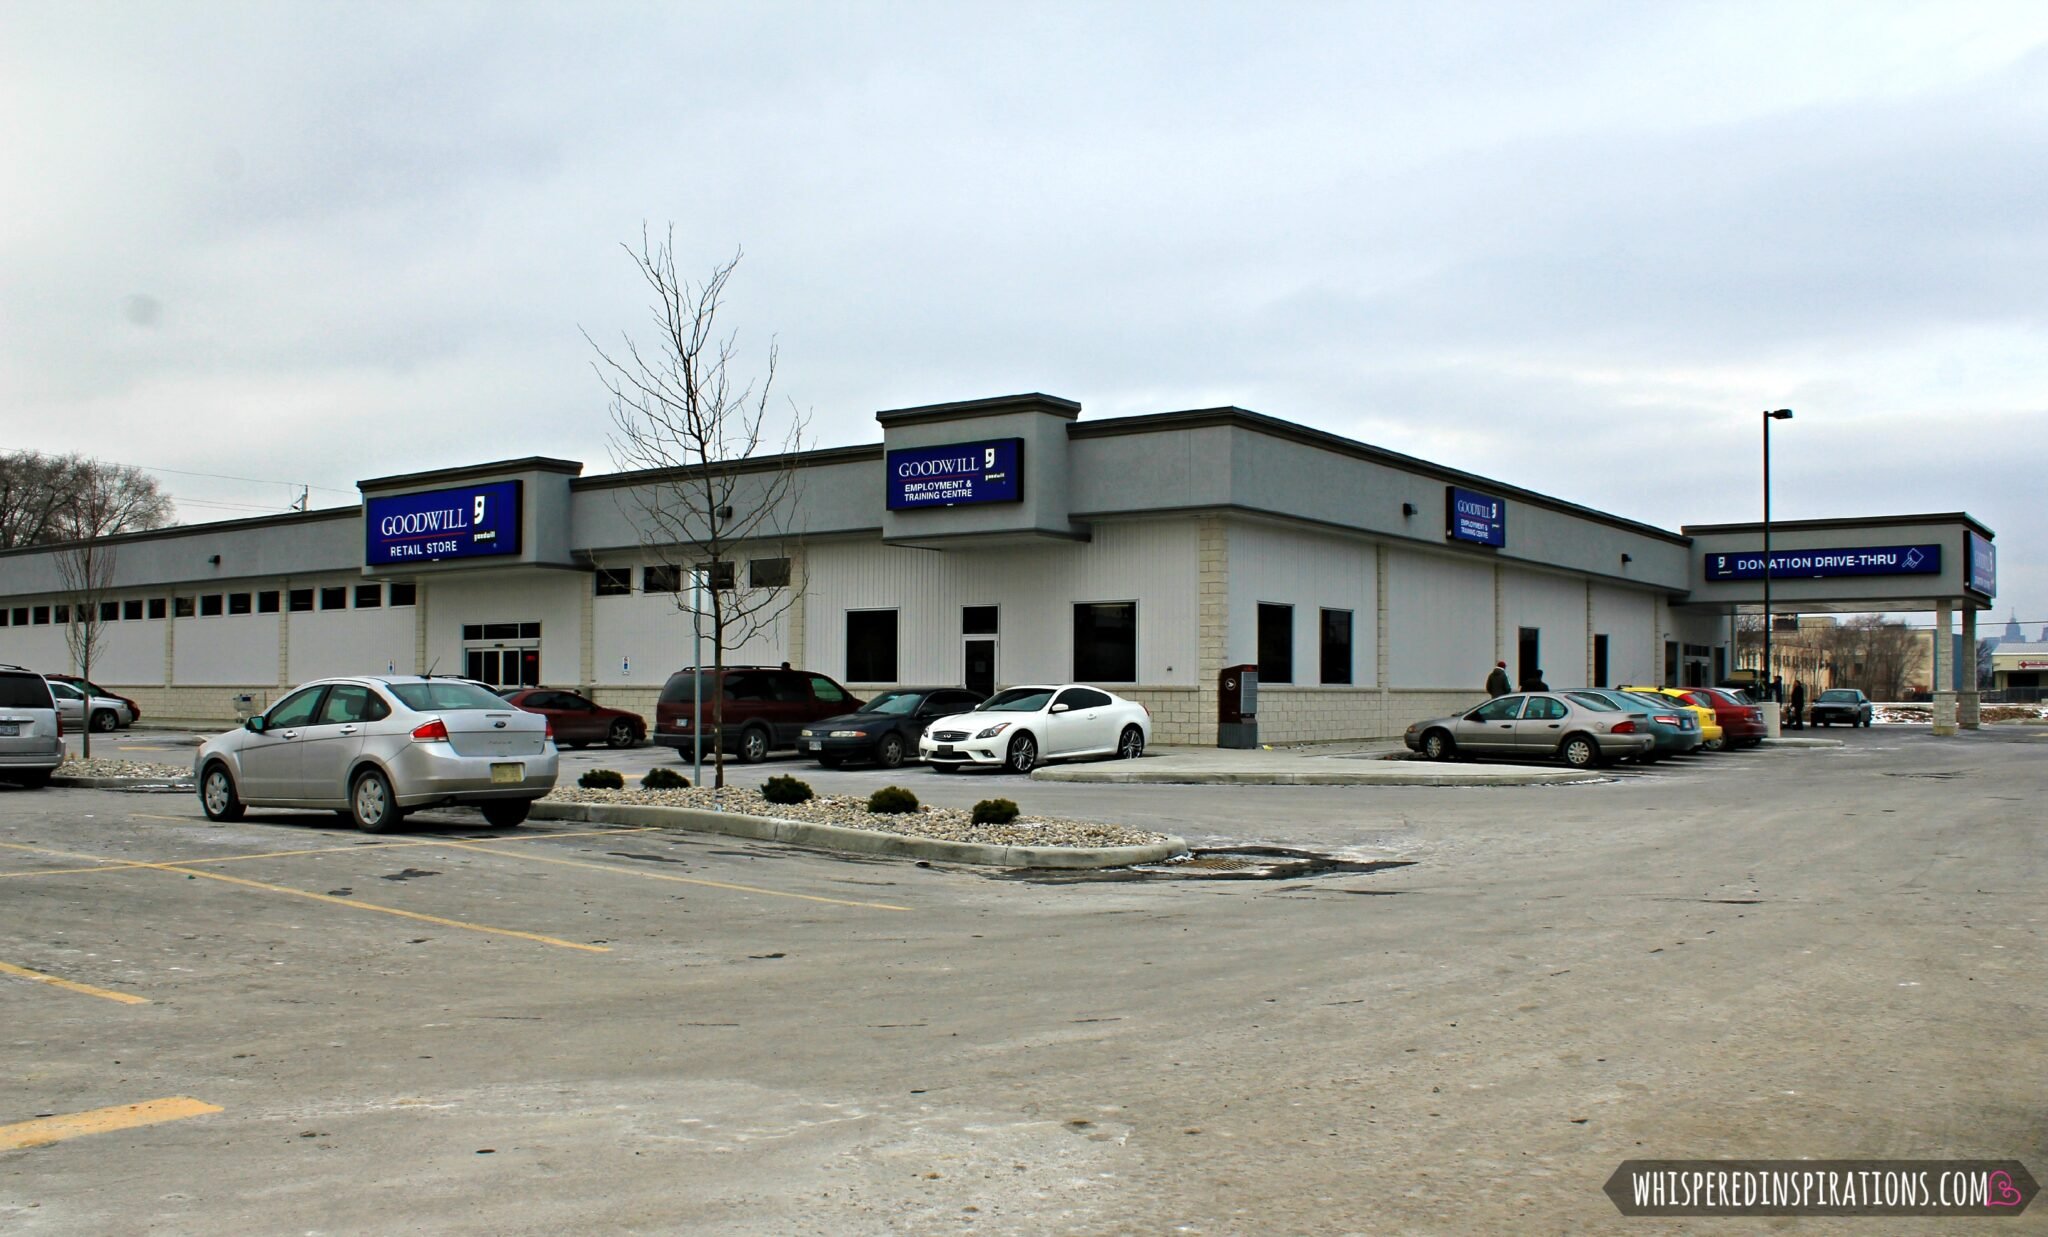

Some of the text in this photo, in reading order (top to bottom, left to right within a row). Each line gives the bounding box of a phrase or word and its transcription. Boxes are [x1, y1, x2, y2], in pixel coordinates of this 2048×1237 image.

[898, 457, 979, 477] GOODWILL
[905, 479, 972, 492] EMPLOYMENT &
[904, 488, 973, 501] TRAINING CENTRE
[1458, 500, 1490, 518] GOODWILL
[381, 508, 468, 536] GOODWILL
[390, 540, 457, 557] RETAIL STORE
[1738, 553, 1897, 570] DONATION DRIVE-THRU
